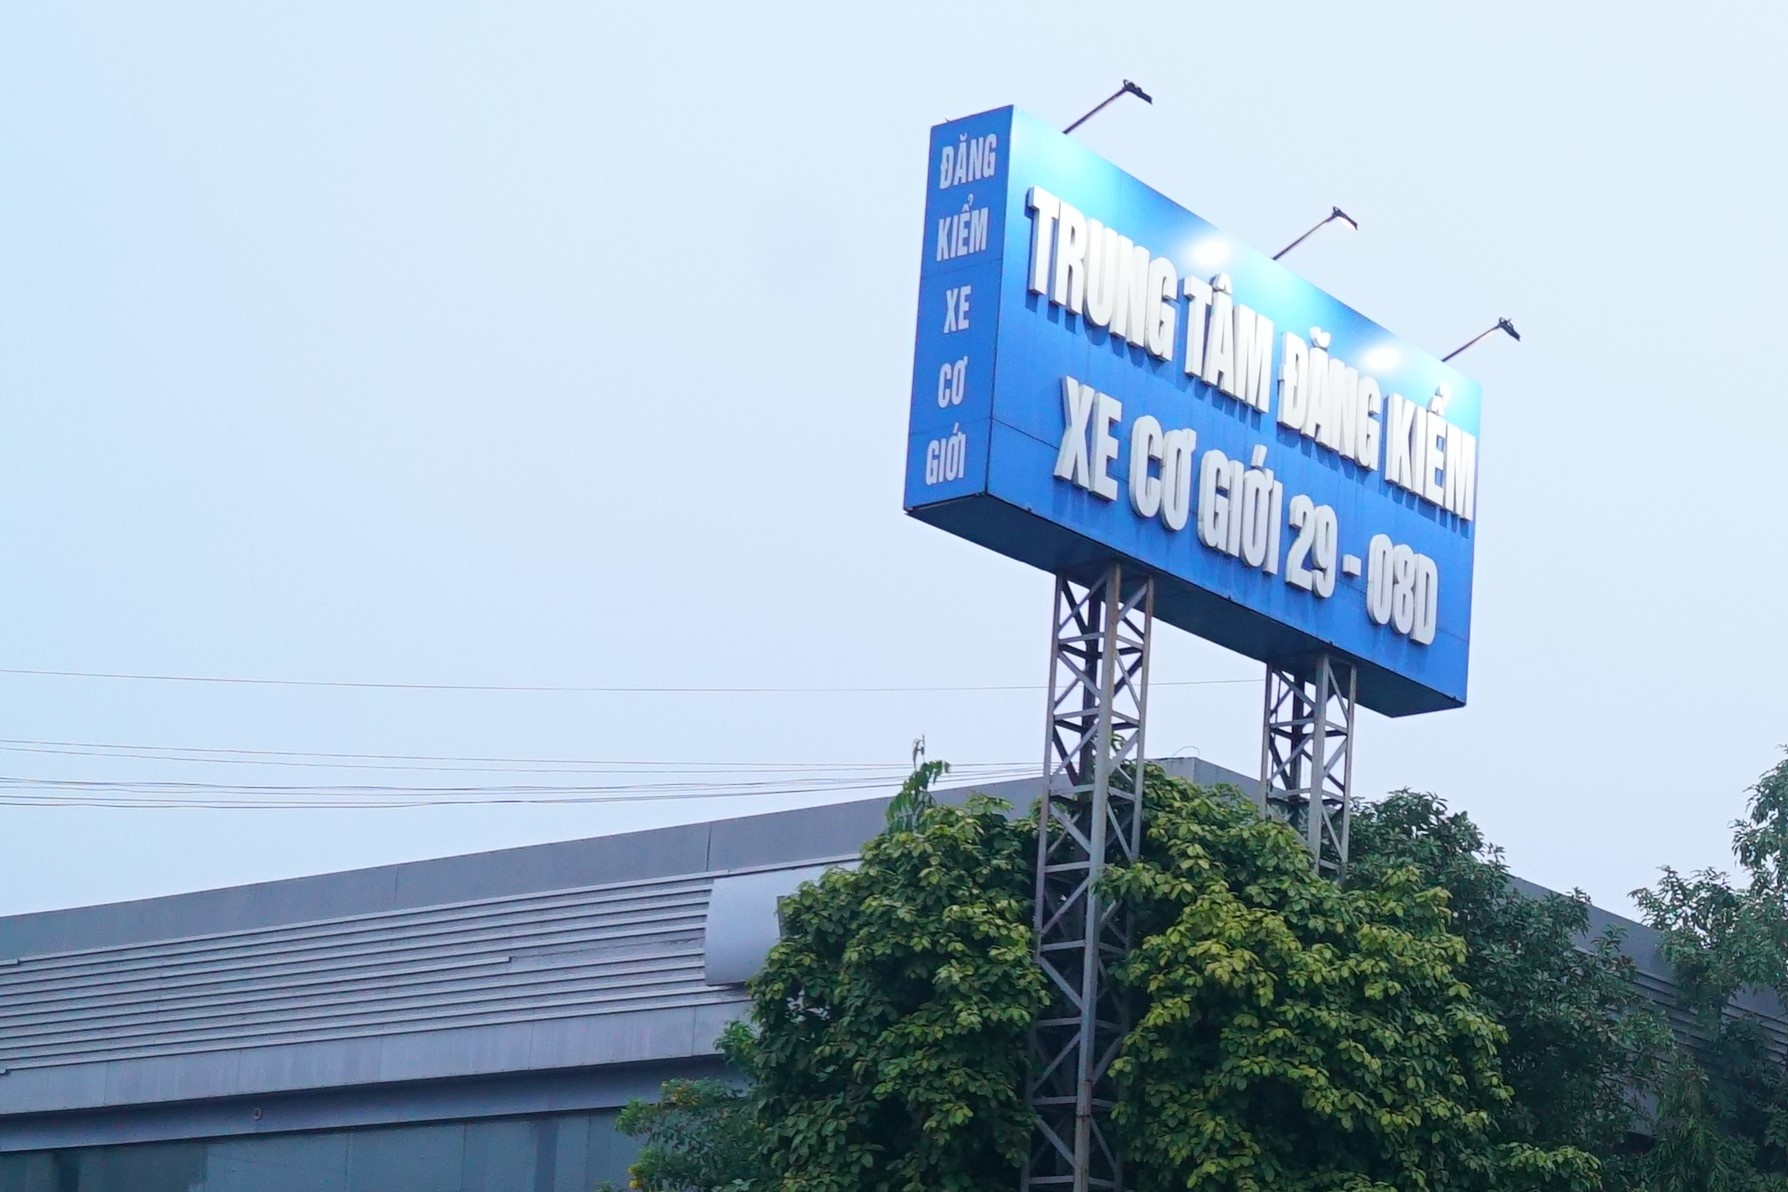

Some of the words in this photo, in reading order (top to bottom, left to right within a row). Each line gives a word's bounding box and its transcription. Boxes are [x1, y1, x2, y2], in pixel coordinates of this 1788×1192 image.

[940, 134, 997, 189] ĐĂNG
[936, 194, 989, 261] KIỂM
[943, 285, 971, 333] XE
[938, 356, 968, 408] CƠ
[1026, 185, 1179, 363] TRUNG
[1183, 273, 1274, 413] TÂM
[1277, 327, 1381, 472] ĐĂNG
[1384, 385, 1476, 522] KIỂM
[925, 422, 965, 486] GIỚI
[1054, 376, 1121, 501] XE
[1129, 415, 1196, 532] CƠ
[1197, 444, 1283, 576] GIỚI
[1285, 495, 1337, 599] 29
[1367, 533, 1439, 646] 08D
